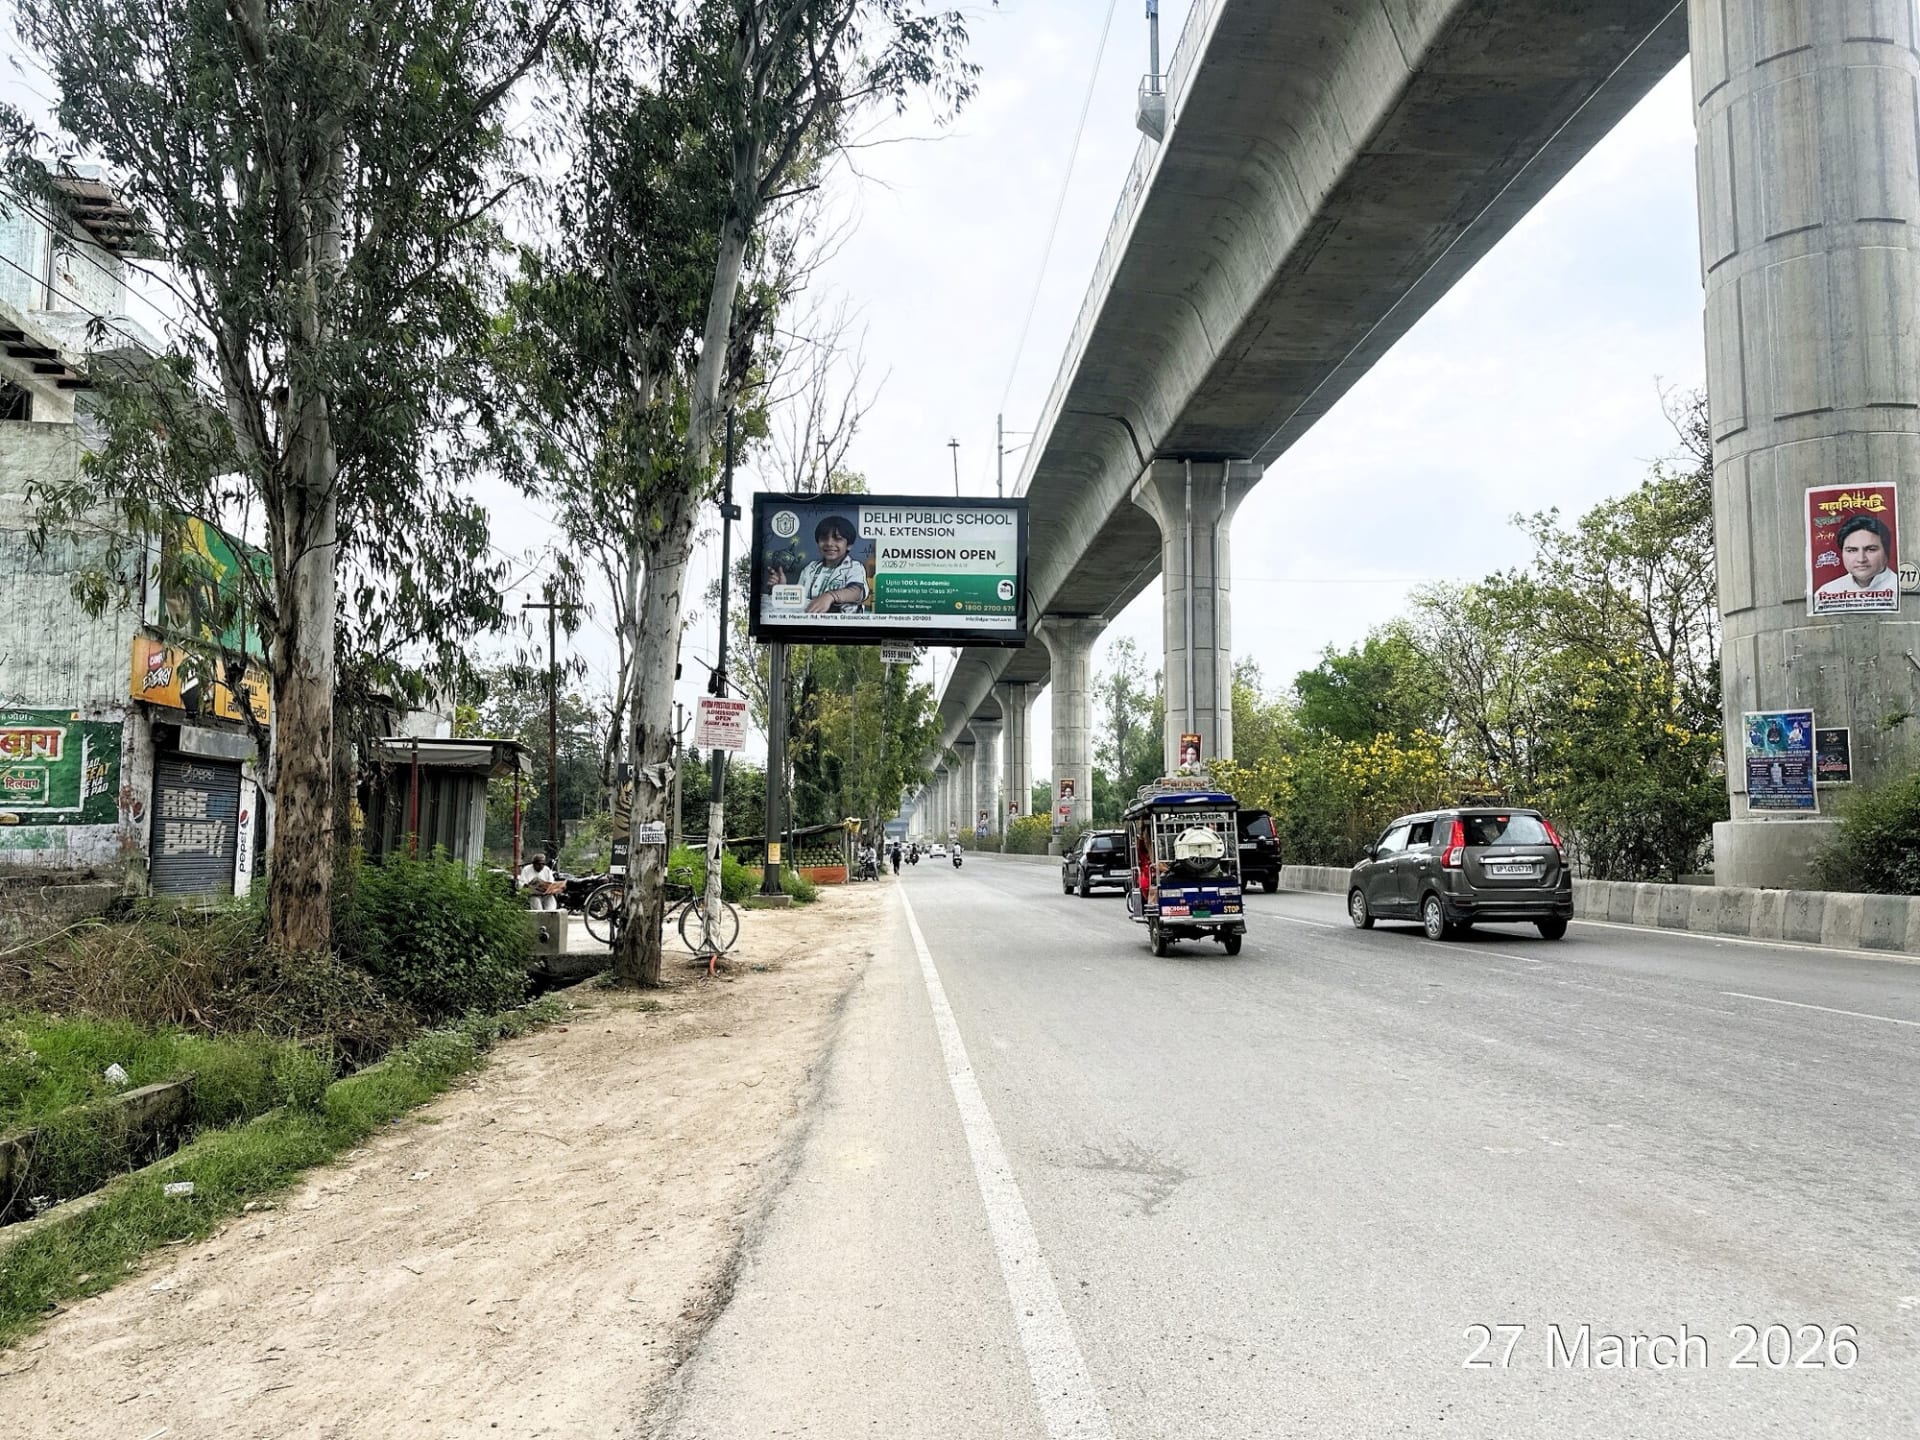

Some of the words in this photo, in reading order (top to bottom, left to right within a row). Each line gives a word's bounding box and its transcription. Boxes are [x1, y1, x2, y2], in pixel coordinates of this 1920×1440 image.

[864, 512, 902, 524] DELHI
[905, 513, 953, 525] PUBLIC
[956, 514, 1013, 526] SCHOOL
[863, 527, 886, 536] R.N.
[889, 527, 955, 537] EXTENSION
[881, 548, 956, 560] ADMISSION
[959, 550, 996, 560] OPEN
[162, 819, 227, 858] BABY!
[239, 831, 248, 873] pepsi
[1223, 905, 1240, 914] STOP
